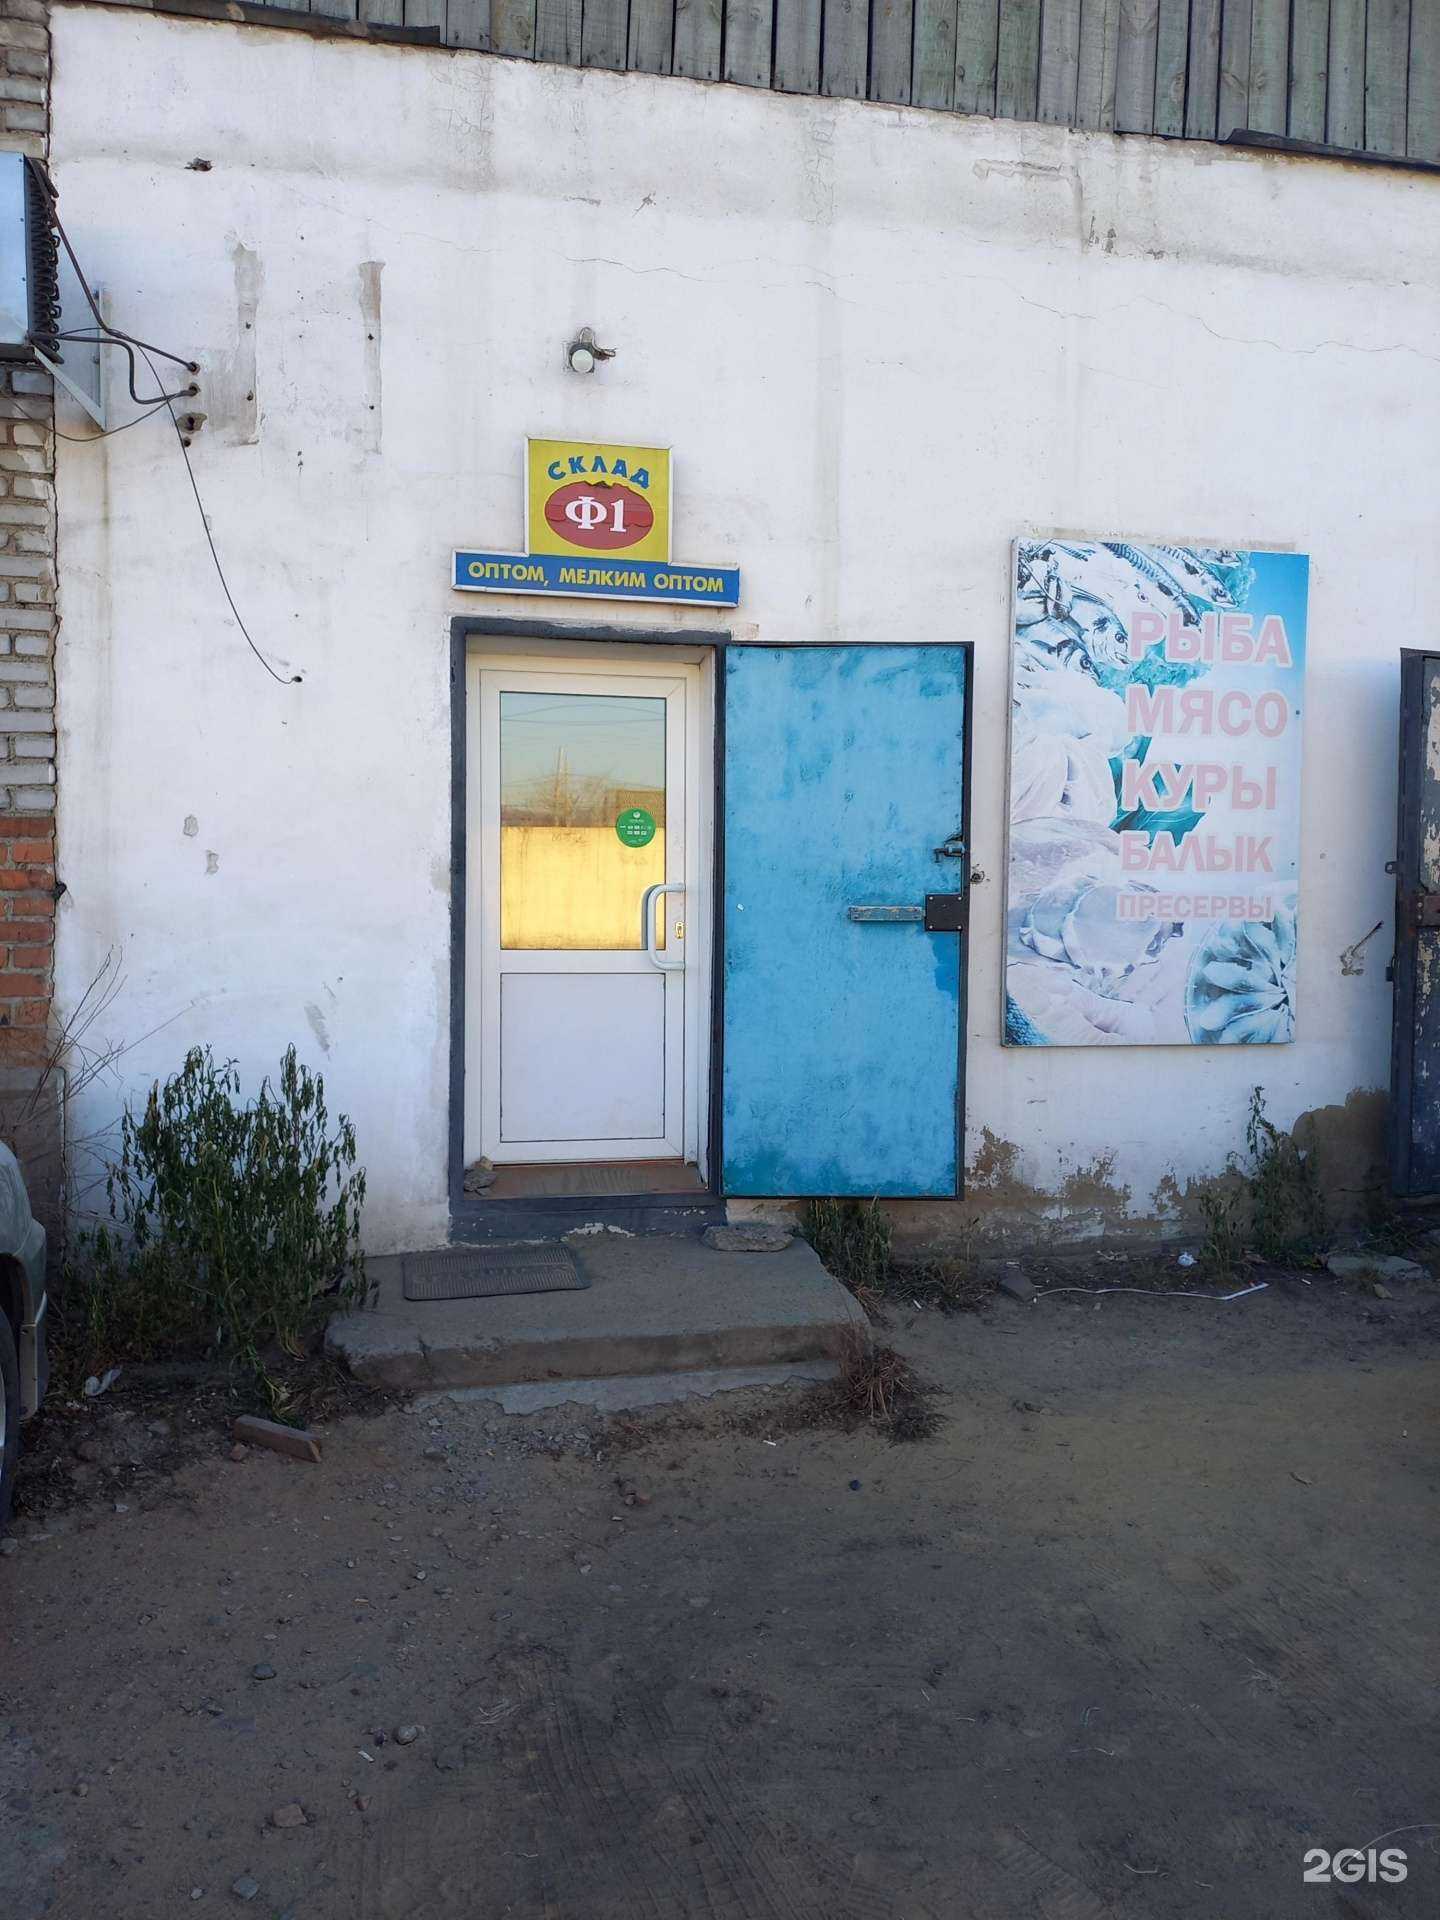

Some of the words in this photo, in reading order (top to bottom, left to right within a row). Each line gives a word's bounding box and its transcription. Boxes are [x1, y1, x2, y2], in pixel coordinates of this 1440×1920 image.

[548, 456, 649, 489] СКЛАД
[565, 496, 626, 533] Ф1
[468, 562, 550, 586] ОПТОМ,
[559, 568, 646, 587] МЕЛКИМ
[654, 574, 723, 592] ОПТОМ
[1131, 612, 1291, 664] РЫБА
[1126, 688, 1287, 738] МЯСО
[1122, 761, 1277, 811] КУРЫ
[1121, 833, 1273, 872] БАЛЫК
[1119, 894, 1272, 918] ПРЕСЕРВЫ
